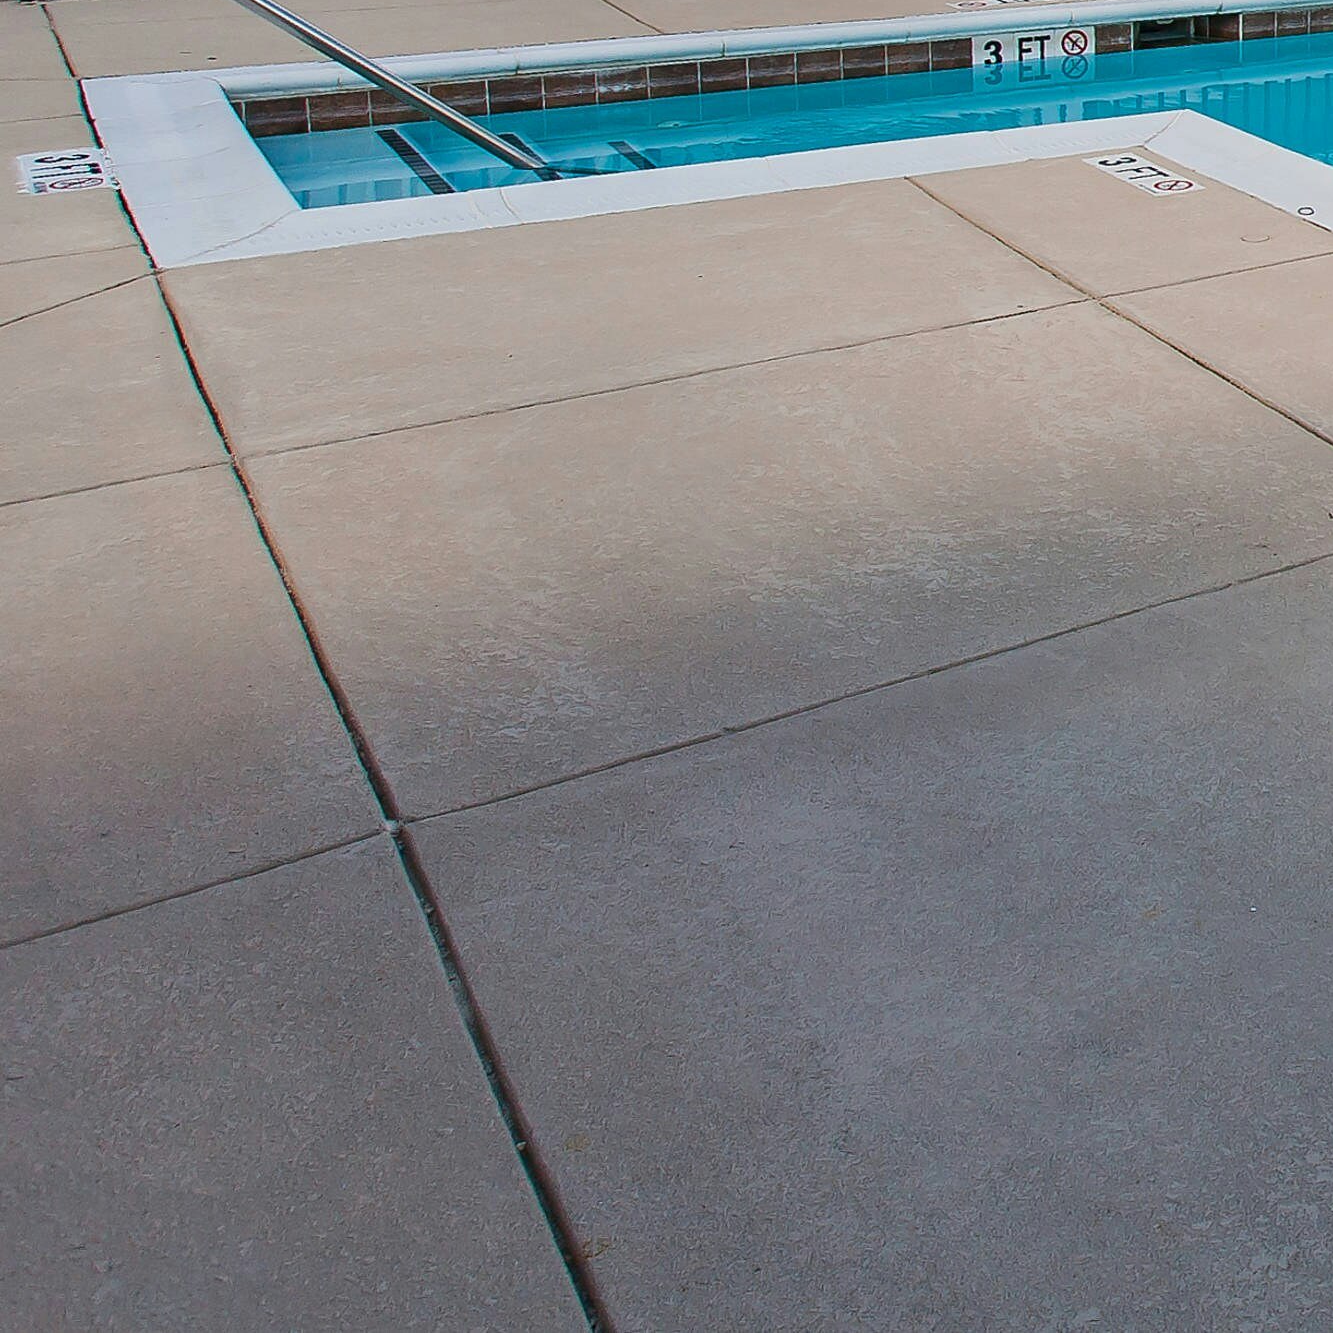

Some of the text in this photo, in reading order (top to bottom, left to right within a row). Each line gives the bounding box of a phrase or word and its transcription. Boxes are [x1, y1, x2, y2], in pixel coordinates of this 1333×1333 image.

[983, 35, 1051, 65] 3 FT
[30, 154, 102, 179] 3 FT
[1098, 157, 1170, 180] 3 FT
